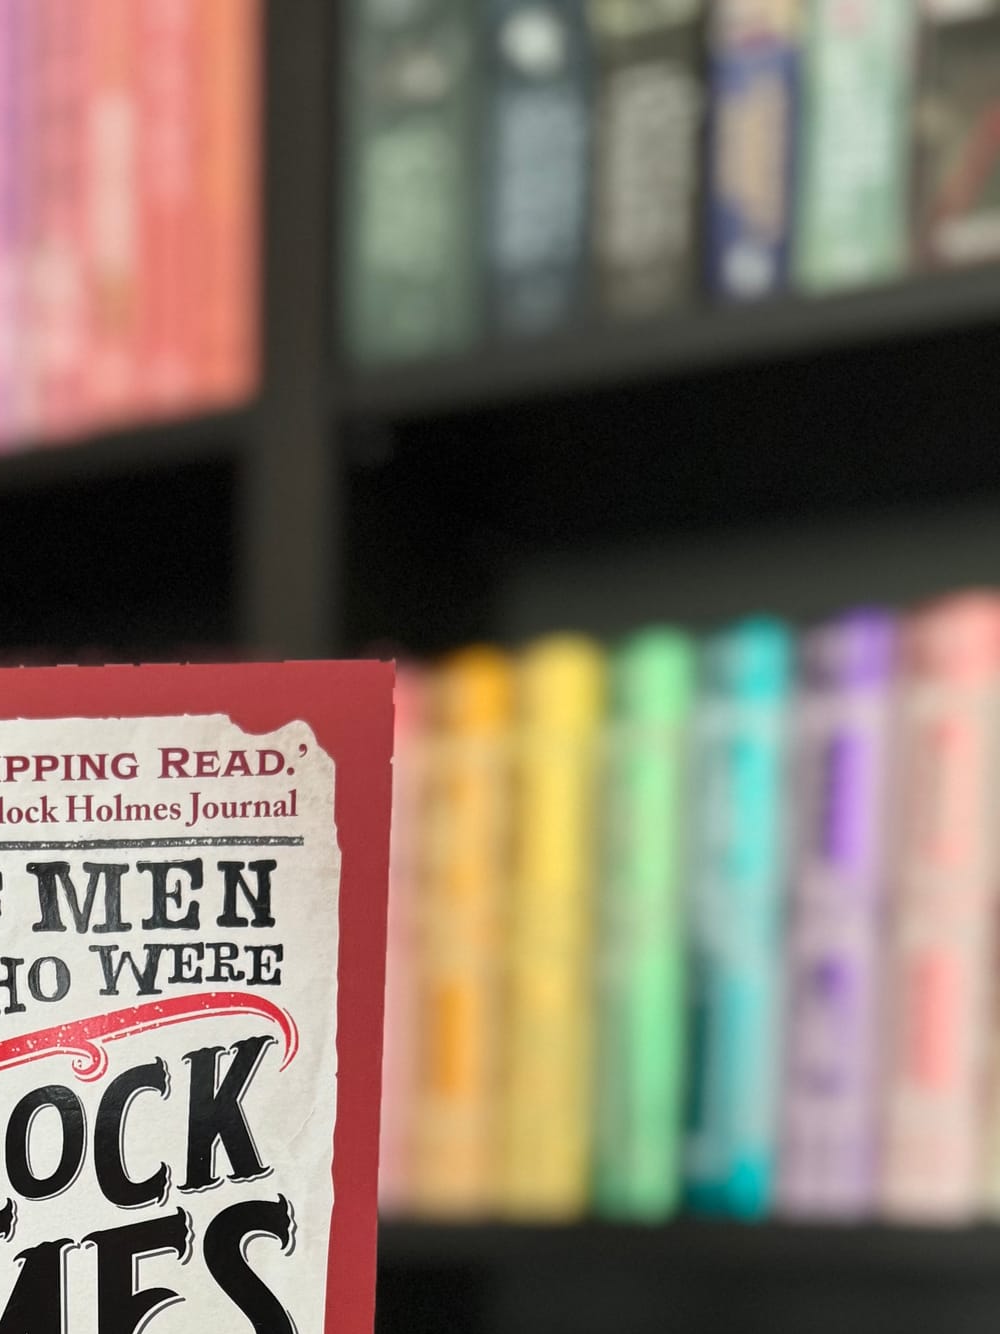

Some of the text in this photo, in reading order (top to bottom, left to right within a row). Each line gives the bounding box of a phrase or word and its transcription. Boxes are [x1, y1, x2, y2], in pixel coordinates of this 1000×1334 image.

[66, 794, 182, 823] Holmes
[185, 790, 299, 827] Journal
[26, 858, 277, 934] MEN
[89, 942, 284, 996] WERE
